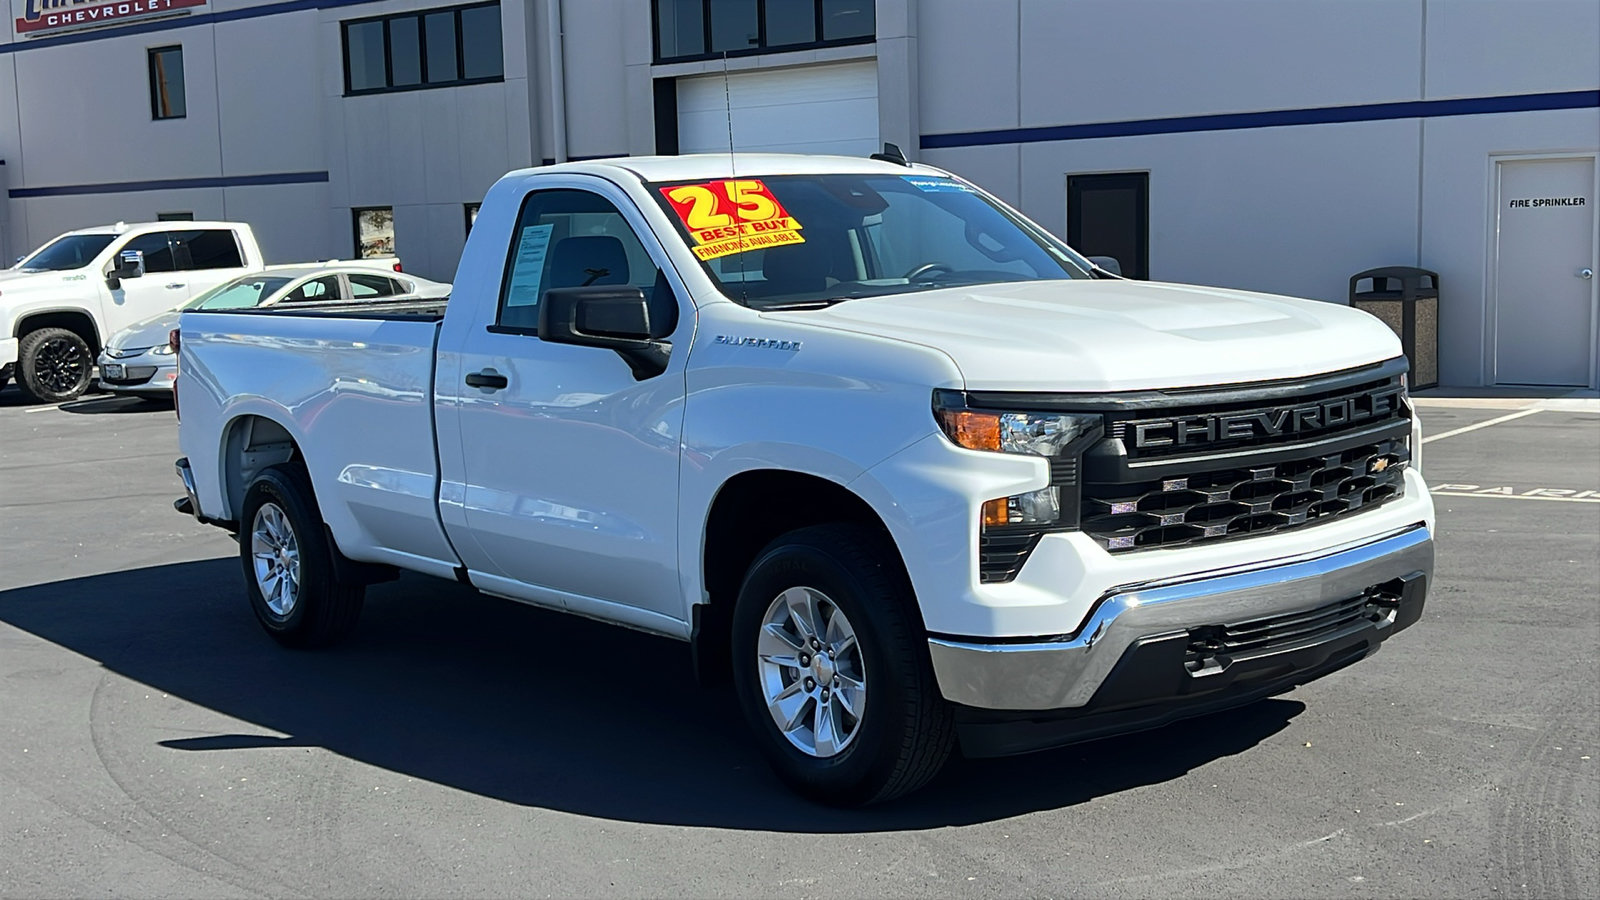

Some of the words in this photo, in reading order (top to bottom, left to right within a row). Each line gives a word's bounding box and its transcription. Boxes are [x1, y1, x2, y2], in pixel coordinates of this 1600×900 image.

[668, 181, 781, 230] 25
[1509, 199, 1530, 208] FIRE
[1532, 197, 1586, 208] SPRINKLER
[699, 224, 748, 242] BEST
[753, 219, 789, 233] BUY
[698, 238, 750, 258] FINANCING
[750, 232, 800, 248] AVAILABLE
[714, 335, 802, 351] SILVERADO
